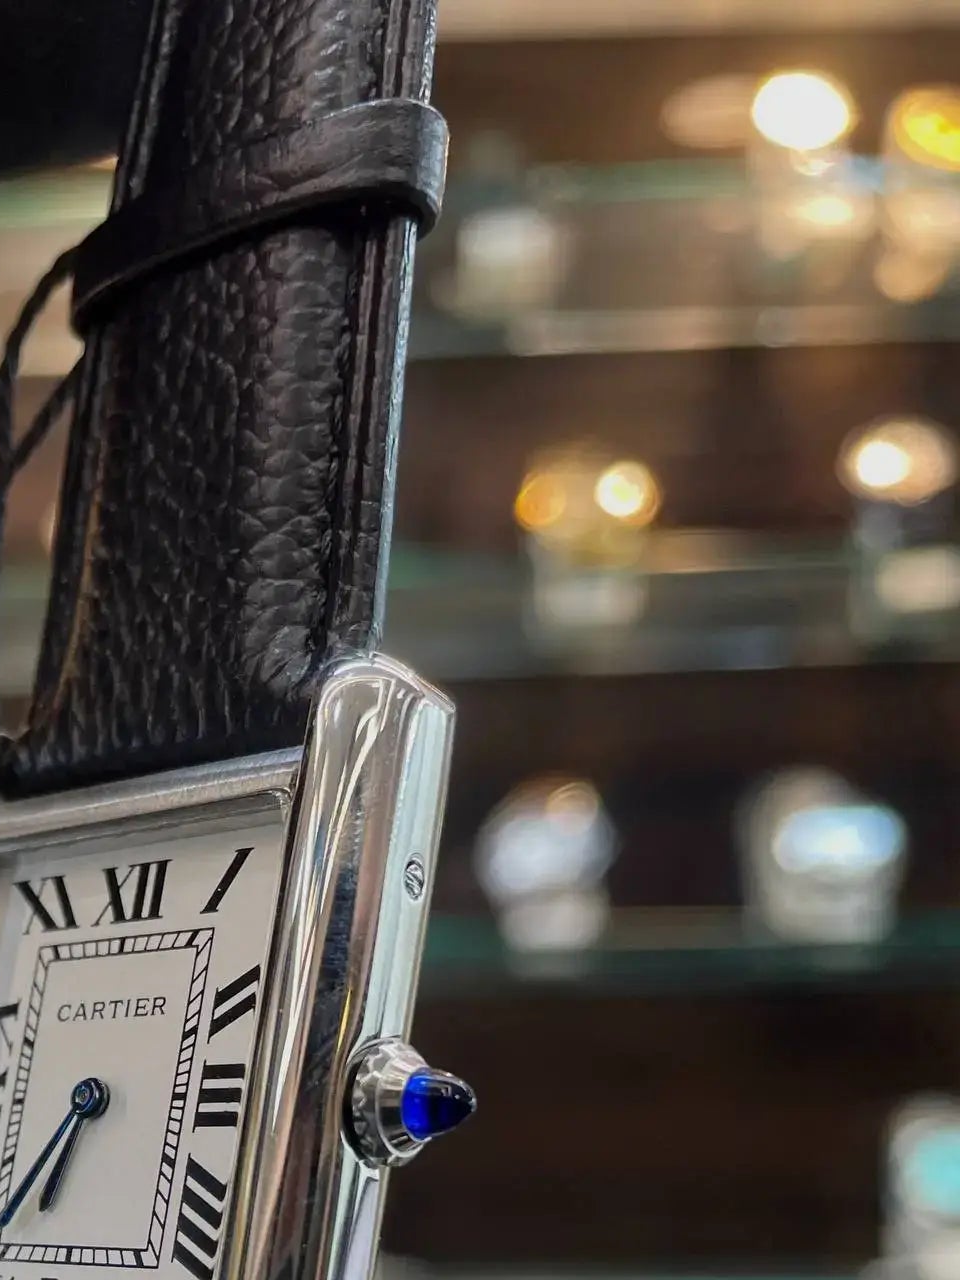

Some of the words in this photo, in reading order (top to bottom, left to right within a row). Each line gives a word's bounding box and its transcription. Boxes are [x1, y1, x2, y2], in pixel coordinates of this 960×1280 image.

[13, 875, 80, 935] XI
[91, 859, 172, 927] XII
[57, 996, 167, 1022] CARTIER
[207, 964, 261, 1044] II
[193, 1059, 246, 1133] III
